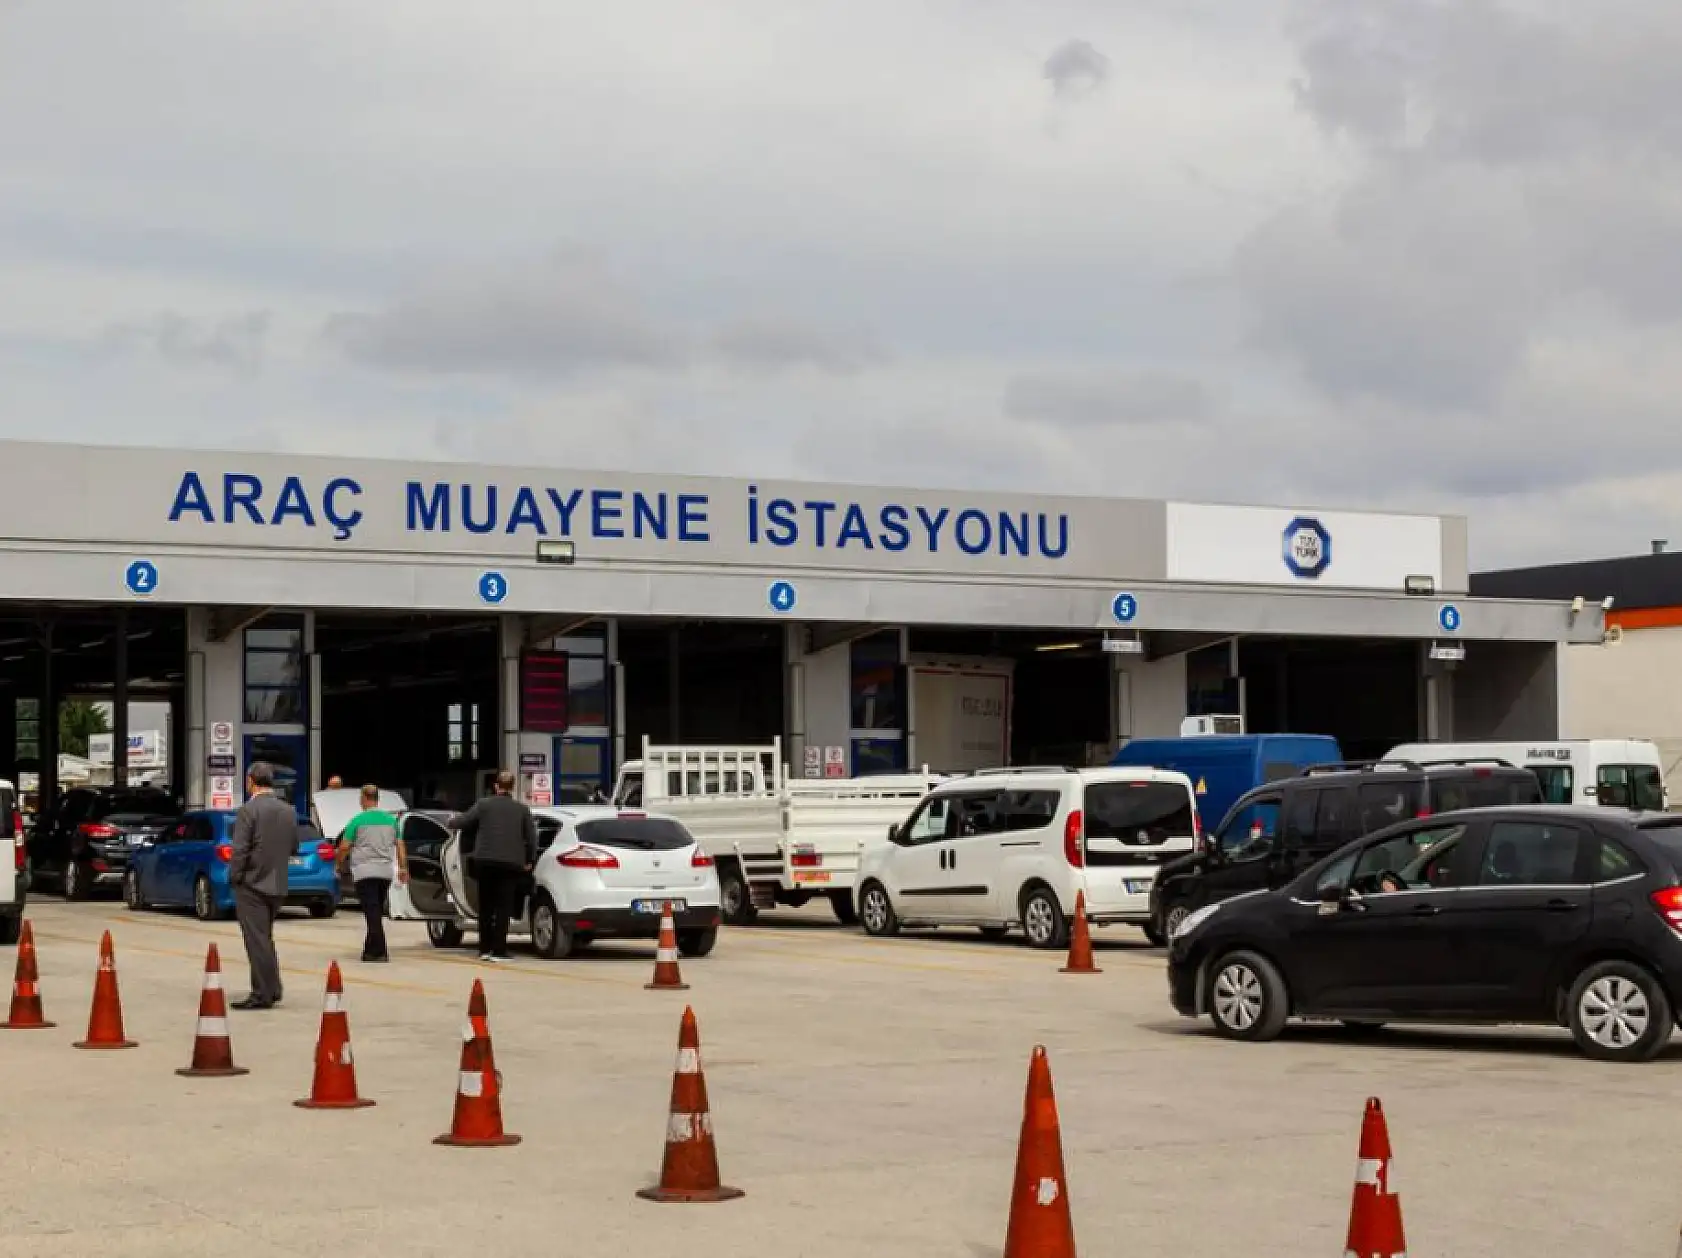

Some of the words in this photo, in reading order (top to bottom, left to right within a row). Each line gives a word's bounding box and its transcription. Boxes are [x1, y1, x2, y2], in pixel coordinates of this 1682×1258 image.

[168, 471, 362, 538] ARAÇ
[406, 482, 710, 542] MUAYENE
[748, 485, 1069, 558] İSTASYONU
[137, 567, 148, 588] 2
[487, 578, 498, 597] 3
[777, 588, 788, 606] 4
[1120, 599, 1130, 616] 5
[1446, 610, 1455, 626] 6
